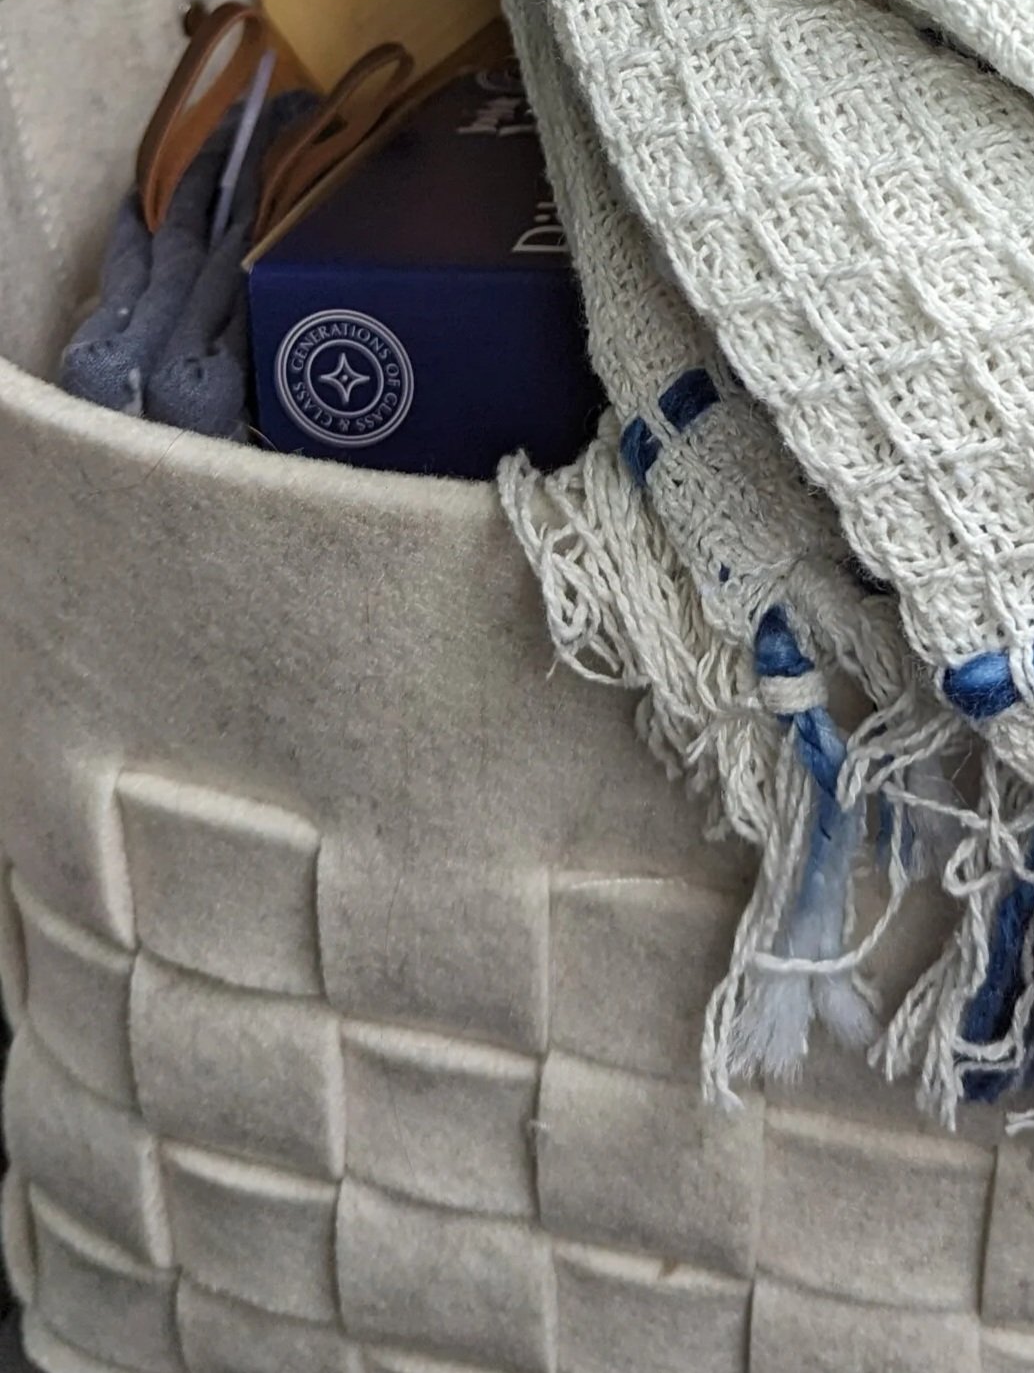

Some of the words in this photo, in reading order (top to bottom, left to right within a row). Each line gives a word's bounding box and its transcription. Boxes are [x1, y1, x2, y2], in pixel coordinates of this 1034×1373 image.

[291, 323, 392, 372] GENERATIONS
[385, 363, 401, 387] OF
[293, 381, 333, 428] CLASS
[356, 392, 399, 431] GLASS
[338, 417, 351, 432] &
